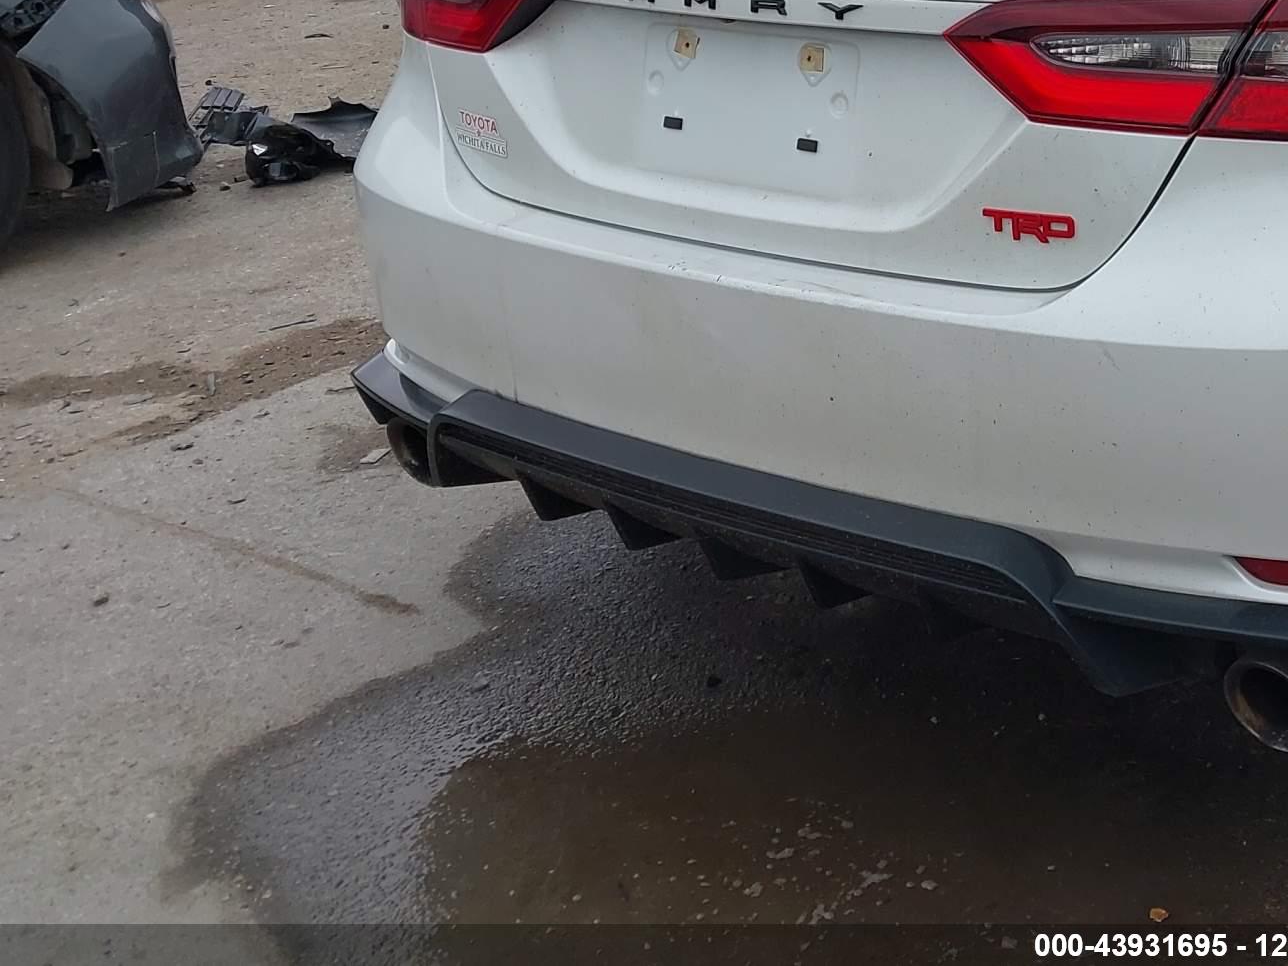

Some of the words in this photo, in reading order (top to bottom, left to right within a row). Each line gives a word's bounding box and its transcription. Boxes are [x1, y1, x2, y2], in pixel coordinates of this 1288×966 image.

[459, 111, 498, 134] TOYOTA
[485, 140, 506, 156] FALLS
[983, 208, 1075, 243] TRD
